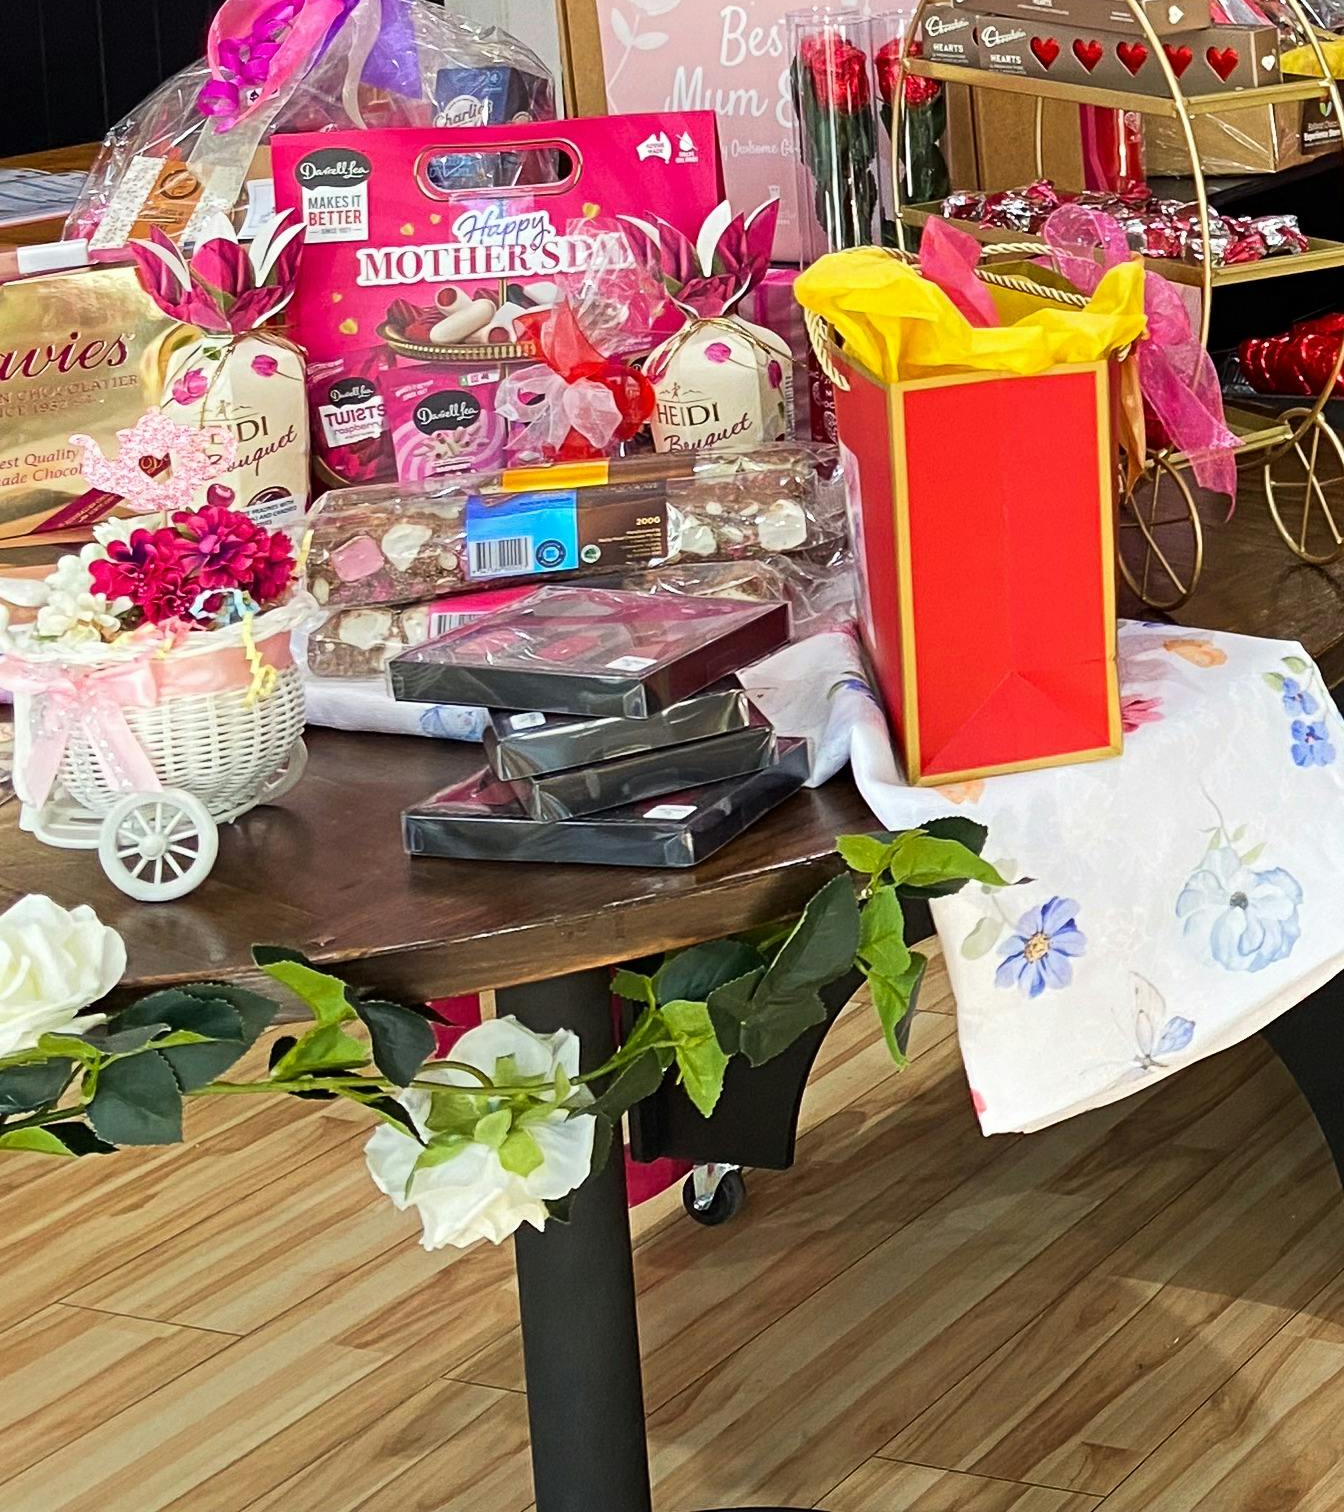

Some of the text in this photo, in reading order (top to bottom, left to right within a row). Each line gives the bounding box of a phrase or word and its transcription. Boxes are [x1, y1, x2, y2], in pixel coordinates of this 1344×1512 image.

[933, 42, 965, 54] HEARTS
[989, 53, 1023, 66] HEARTS
[664, 64, 770, 118] Mum
[308, 194, 362, 210] MAKES IT
[308, 209, 362, 226] BETTER
[457, 210, 548, 252] Happy
[362, 238, 561, 283] MOTHER'S
[655, 401, 721, 427] HEIDI
[24, 448, 80, 468] Quality
[635, 515, 662, 526] 200G
